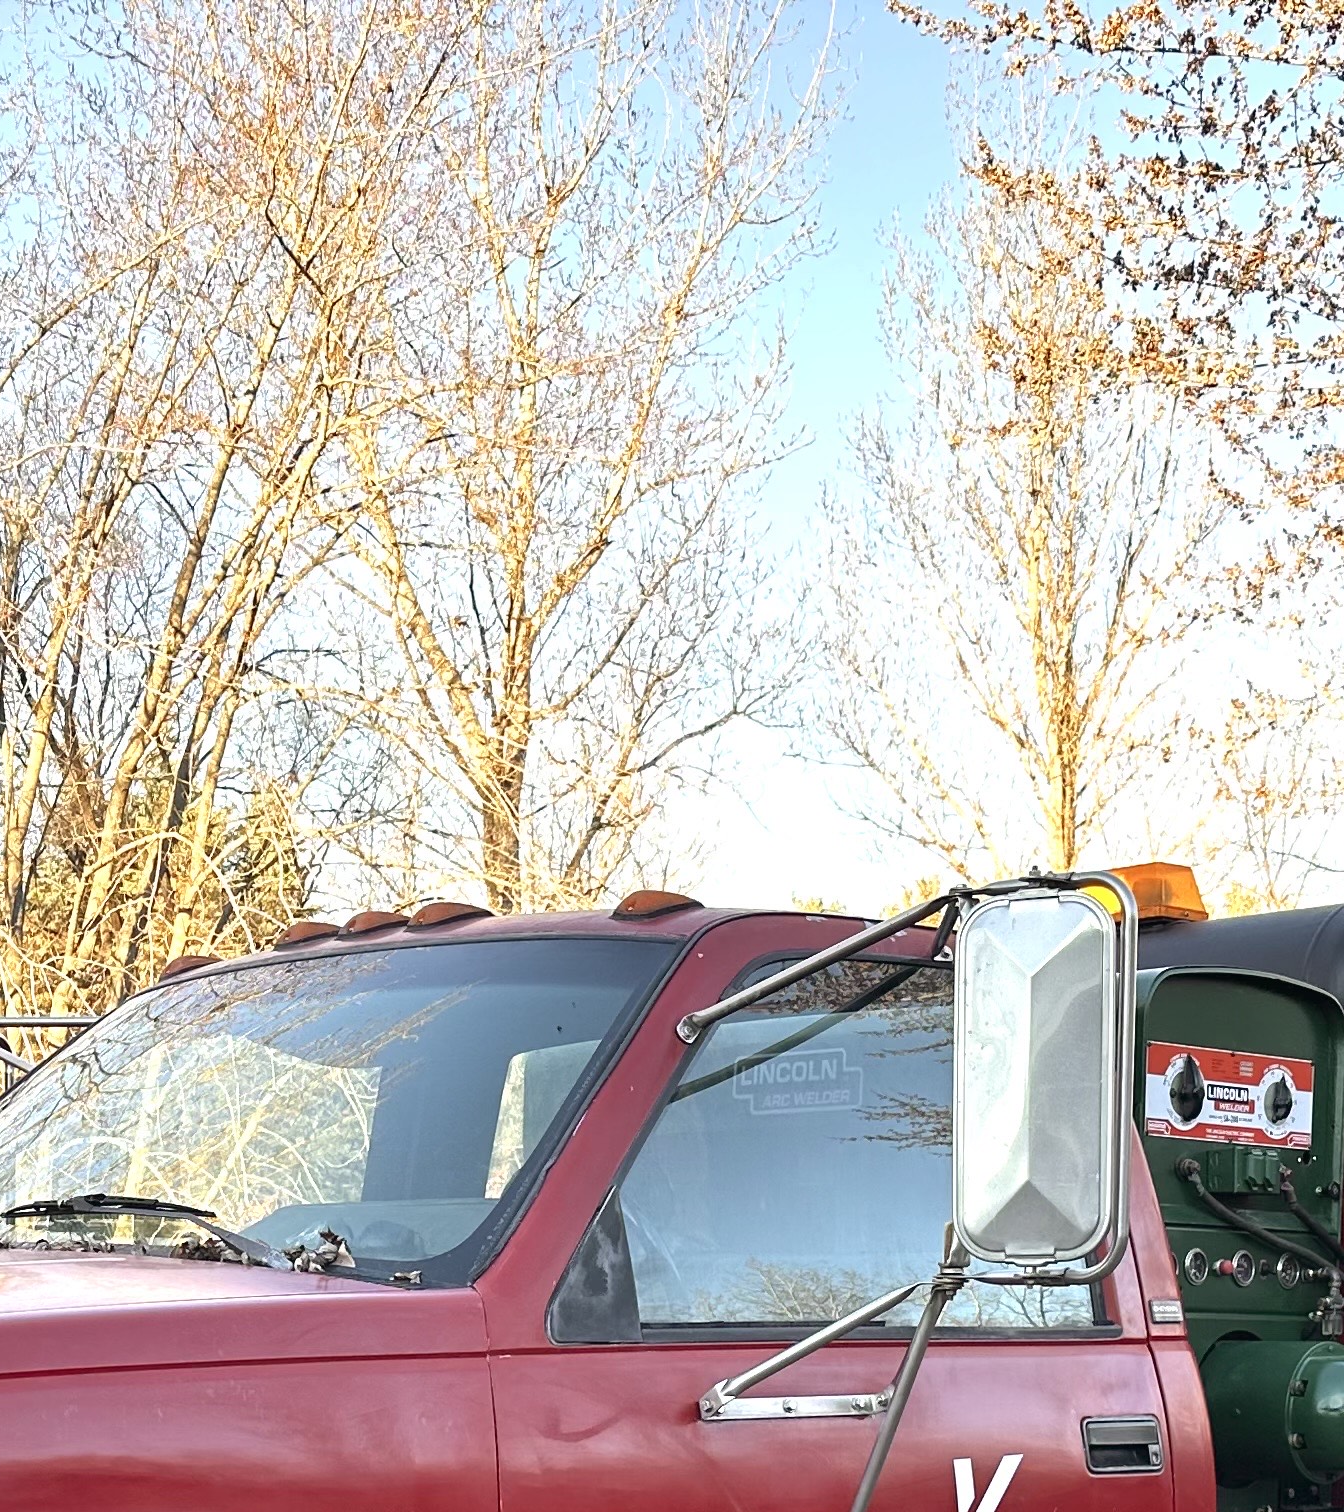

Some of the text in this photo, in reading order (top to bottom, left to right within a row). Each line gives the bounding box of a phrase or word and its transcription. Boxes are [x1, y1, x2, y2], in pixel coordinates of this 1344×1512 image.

[741, 1058, 837, 1086] LINCOLN
[762, 1090, 850, 1108] ARC WELDER
[1208, 1085, 1248, 1102] LINCOLN
[1219, 1102, 1250, 1113] WELDER
